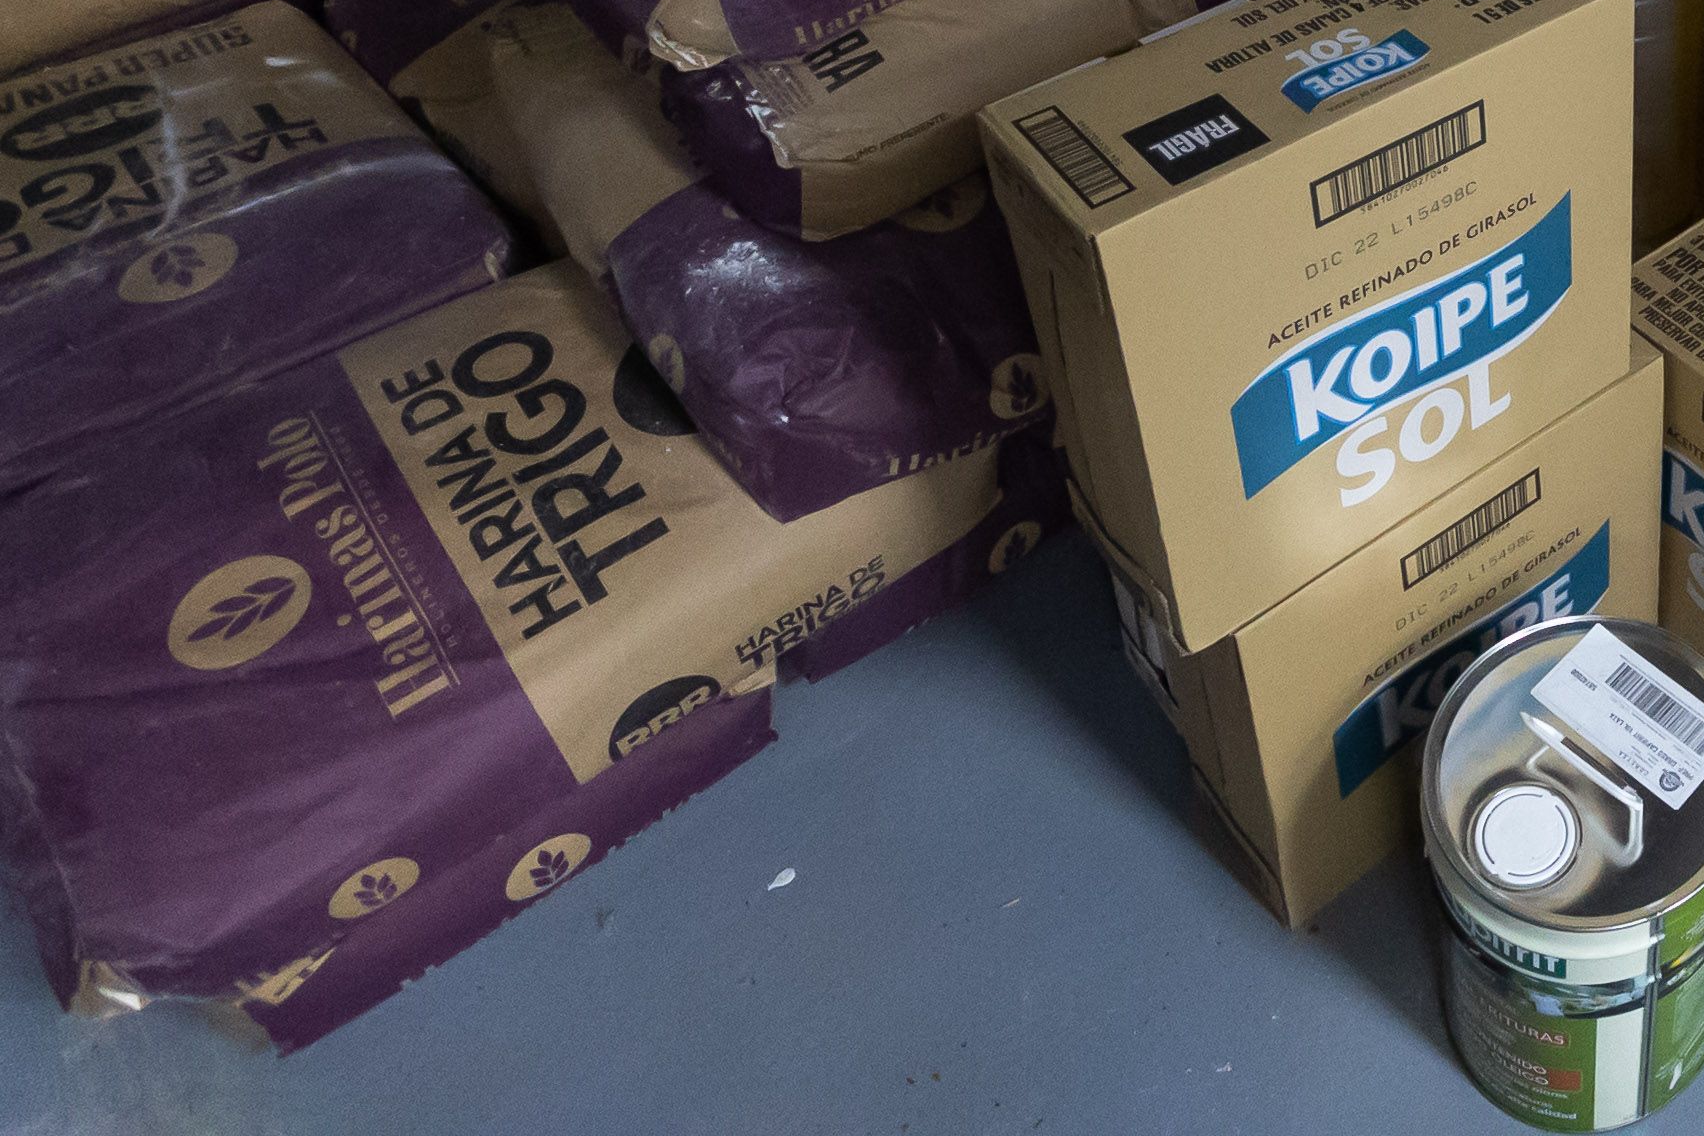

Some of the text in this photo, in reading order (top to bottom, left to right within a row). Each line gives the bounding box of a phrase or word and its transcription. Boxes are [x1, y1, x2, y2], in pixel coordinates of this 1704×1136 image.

[1230, 7, 1262, 29] SOL
[1295, 7, 1348, 36] CAJAS
[1352, 2, 1364, 13] 4
[1485, 3, 1500, 20] 5
[1204, 40, 1268, 74] ALTURA
[1271, 30, 1294, 49] DE
[1284, 26, 1370, 70] SOL
[1299, 41, 1415, 100] KOIPE
[1148, 113, 1240, 161] FRÁGIL
[1304, 250, 1344, 280] DIC
[1354, 232, 1380, 255] 22
[1664, 247, 1704, 275] POR
[1690, 235, 1704, 245] 3
[1268, 192, 1538, 349] ACEITE REFINADO DE GIRASOL
[1652, 259, 1684, 284] PARA
[1652, 293, 1693, 325] MEJOR
[1666, 288, 1687, 304] NO
[1286, 252, 1529, 444] KOIPE
[1638, 306, 1701, 353] PRESERVAR
[1336, 360, 1511, 508] SOL
[1666, 426, 1704, 460] ACEITE
[451, 331, 670, 605] TRIGO
[382, 359, 582, 640] HARINA DE
[257, 417, 454, 721] Harinas Polo
[735, 553, 885, 660] HARINA DE
[1363, 645, 1418, 687] ACEITE
[1421, 586, 1497, 647] REFINADO
[1501, 571, 1521, 592] DE
[1524, 526, 1582, 574] GIRASOL
[1395, 604, 1427, 631] DIC
[1439, 582, 1458, 603] 22
[614, 684, 712, 759] RRR
